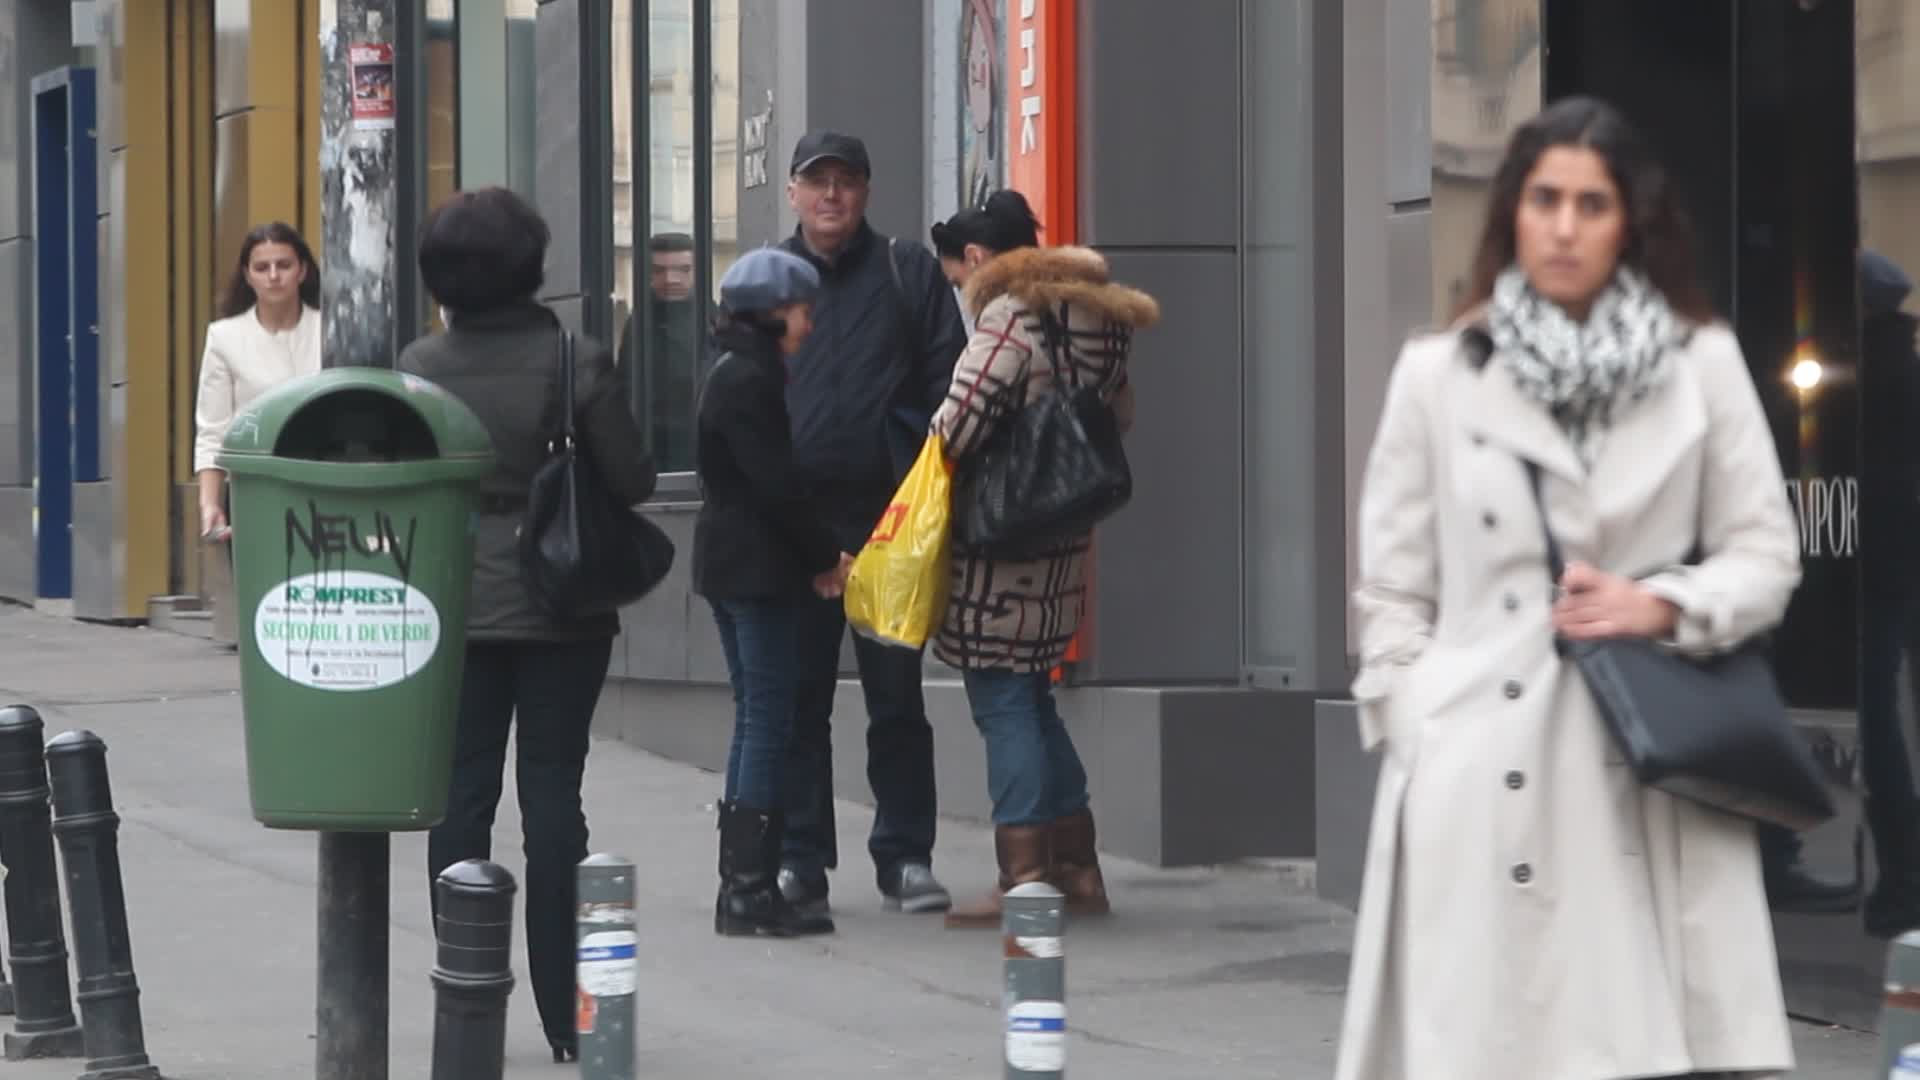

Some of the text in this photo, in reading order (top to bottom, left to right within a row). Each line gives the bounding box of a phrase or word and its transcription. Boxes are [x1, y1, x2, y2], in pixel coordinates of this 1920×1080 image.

[287, 586, 406, 605] ROMPREST
[263, 622, 432, 641] SECTORUL 1 DE VERDE
